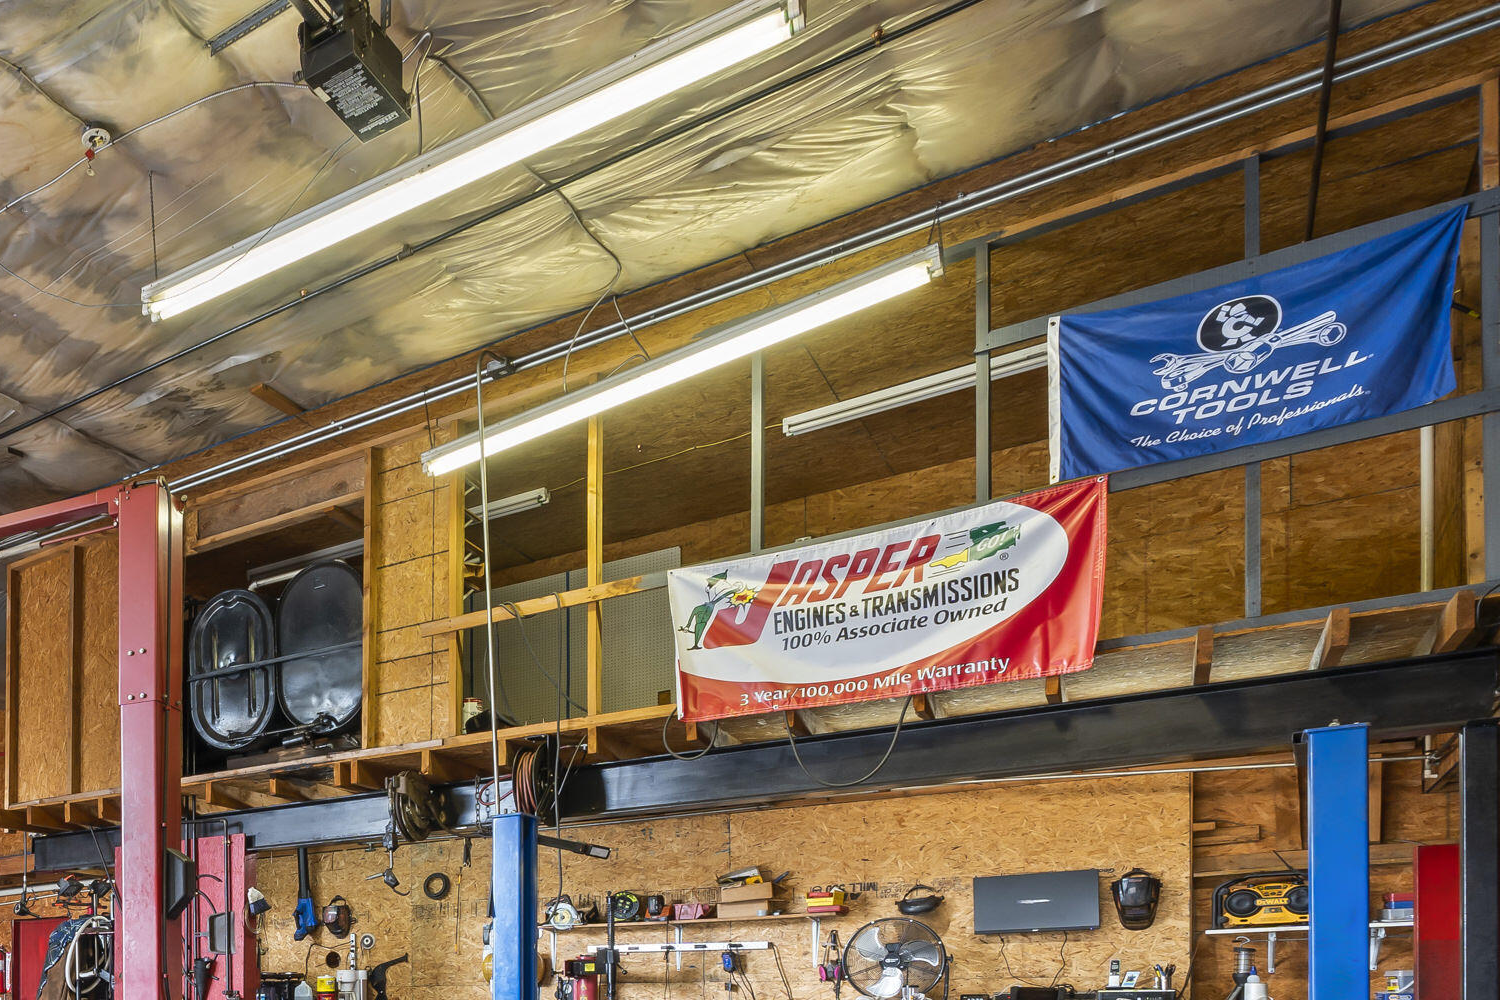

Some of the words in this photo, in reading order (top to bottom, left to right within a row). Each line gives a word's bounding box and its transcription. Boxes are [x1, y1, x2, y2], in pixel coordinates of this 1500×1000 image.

[1130, 350, 1367, 417] CORNWELL
[1171, 379, 1314, 425] TOOLS
[1130, 435, 1161, 448] The
[1165, 427, 1222, 444] Choice
[1225, 416, 1244, 436] of
[1247, 384, 1365, 430] Professionals
[702, 534, 942, 650] JASPER
[773, 602, 846, 635] ENGINES
[849, 604, 859, 618] &
[861, 567, 1020, 620] TRANSMISSIONS
[781, 631, 832, 651] 100%
[835, 611, 928, 643] Associate
[934, 597, 1008, 625] Owned
[740, 693, 749, 706] 3
[754, 679, 869, 703] Year/100,000
[873, 672, 912, 690] Mile
[917, 657, 1011, 682] Warranty
